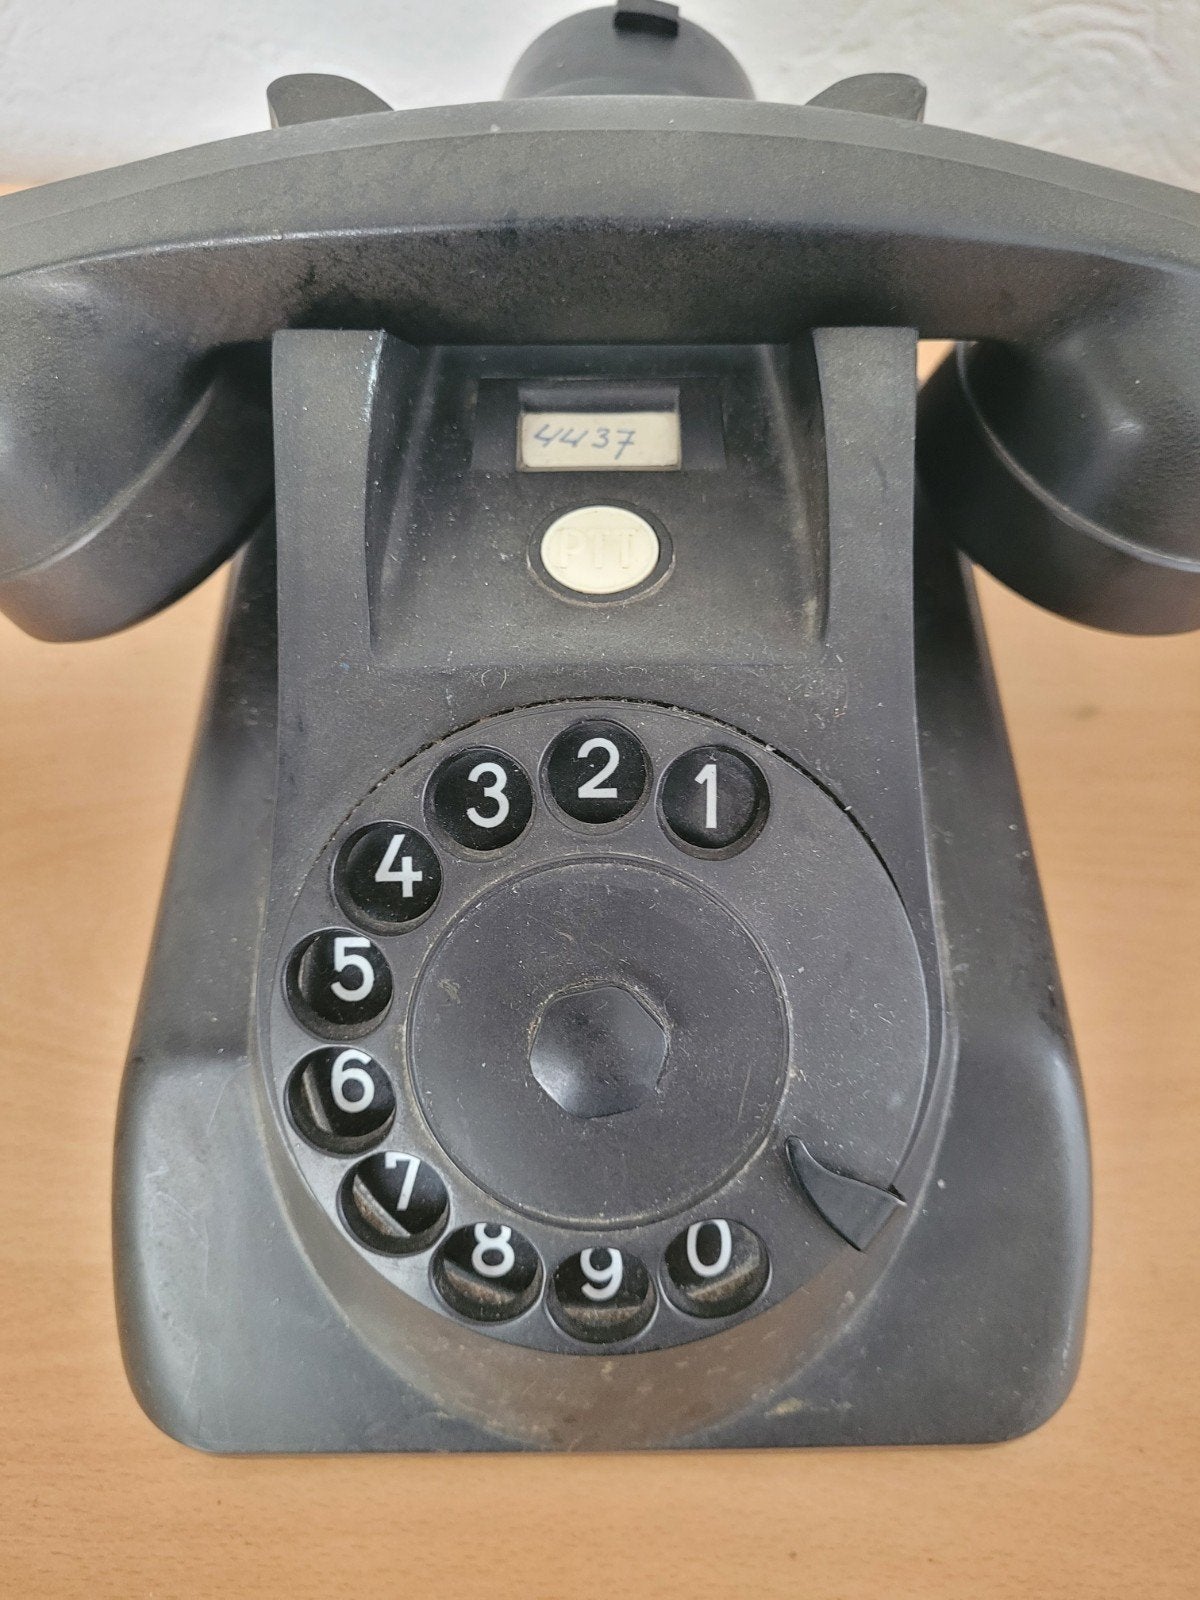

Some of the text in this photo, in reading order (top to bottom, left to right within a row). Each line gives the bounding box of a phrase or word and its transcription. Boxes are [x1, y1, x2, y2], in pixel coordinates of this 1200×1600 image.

[534, 423, 637, 460] 4437
[466, 762, 510, 829] 3
[577, 737, 620, 800] 2
[694, 763, 718, 829] 1
[374, 833, 423, 898] 4
[330, 936, 375, 1002] 5
[330, 1049, 375, 1114] 6
[384, 1152, 421, 1211] 7
[472, 1222, 515, 1277] 8
[580, 1247, 624, 1301] 9
[687, 1219, 732, 1278] 0
